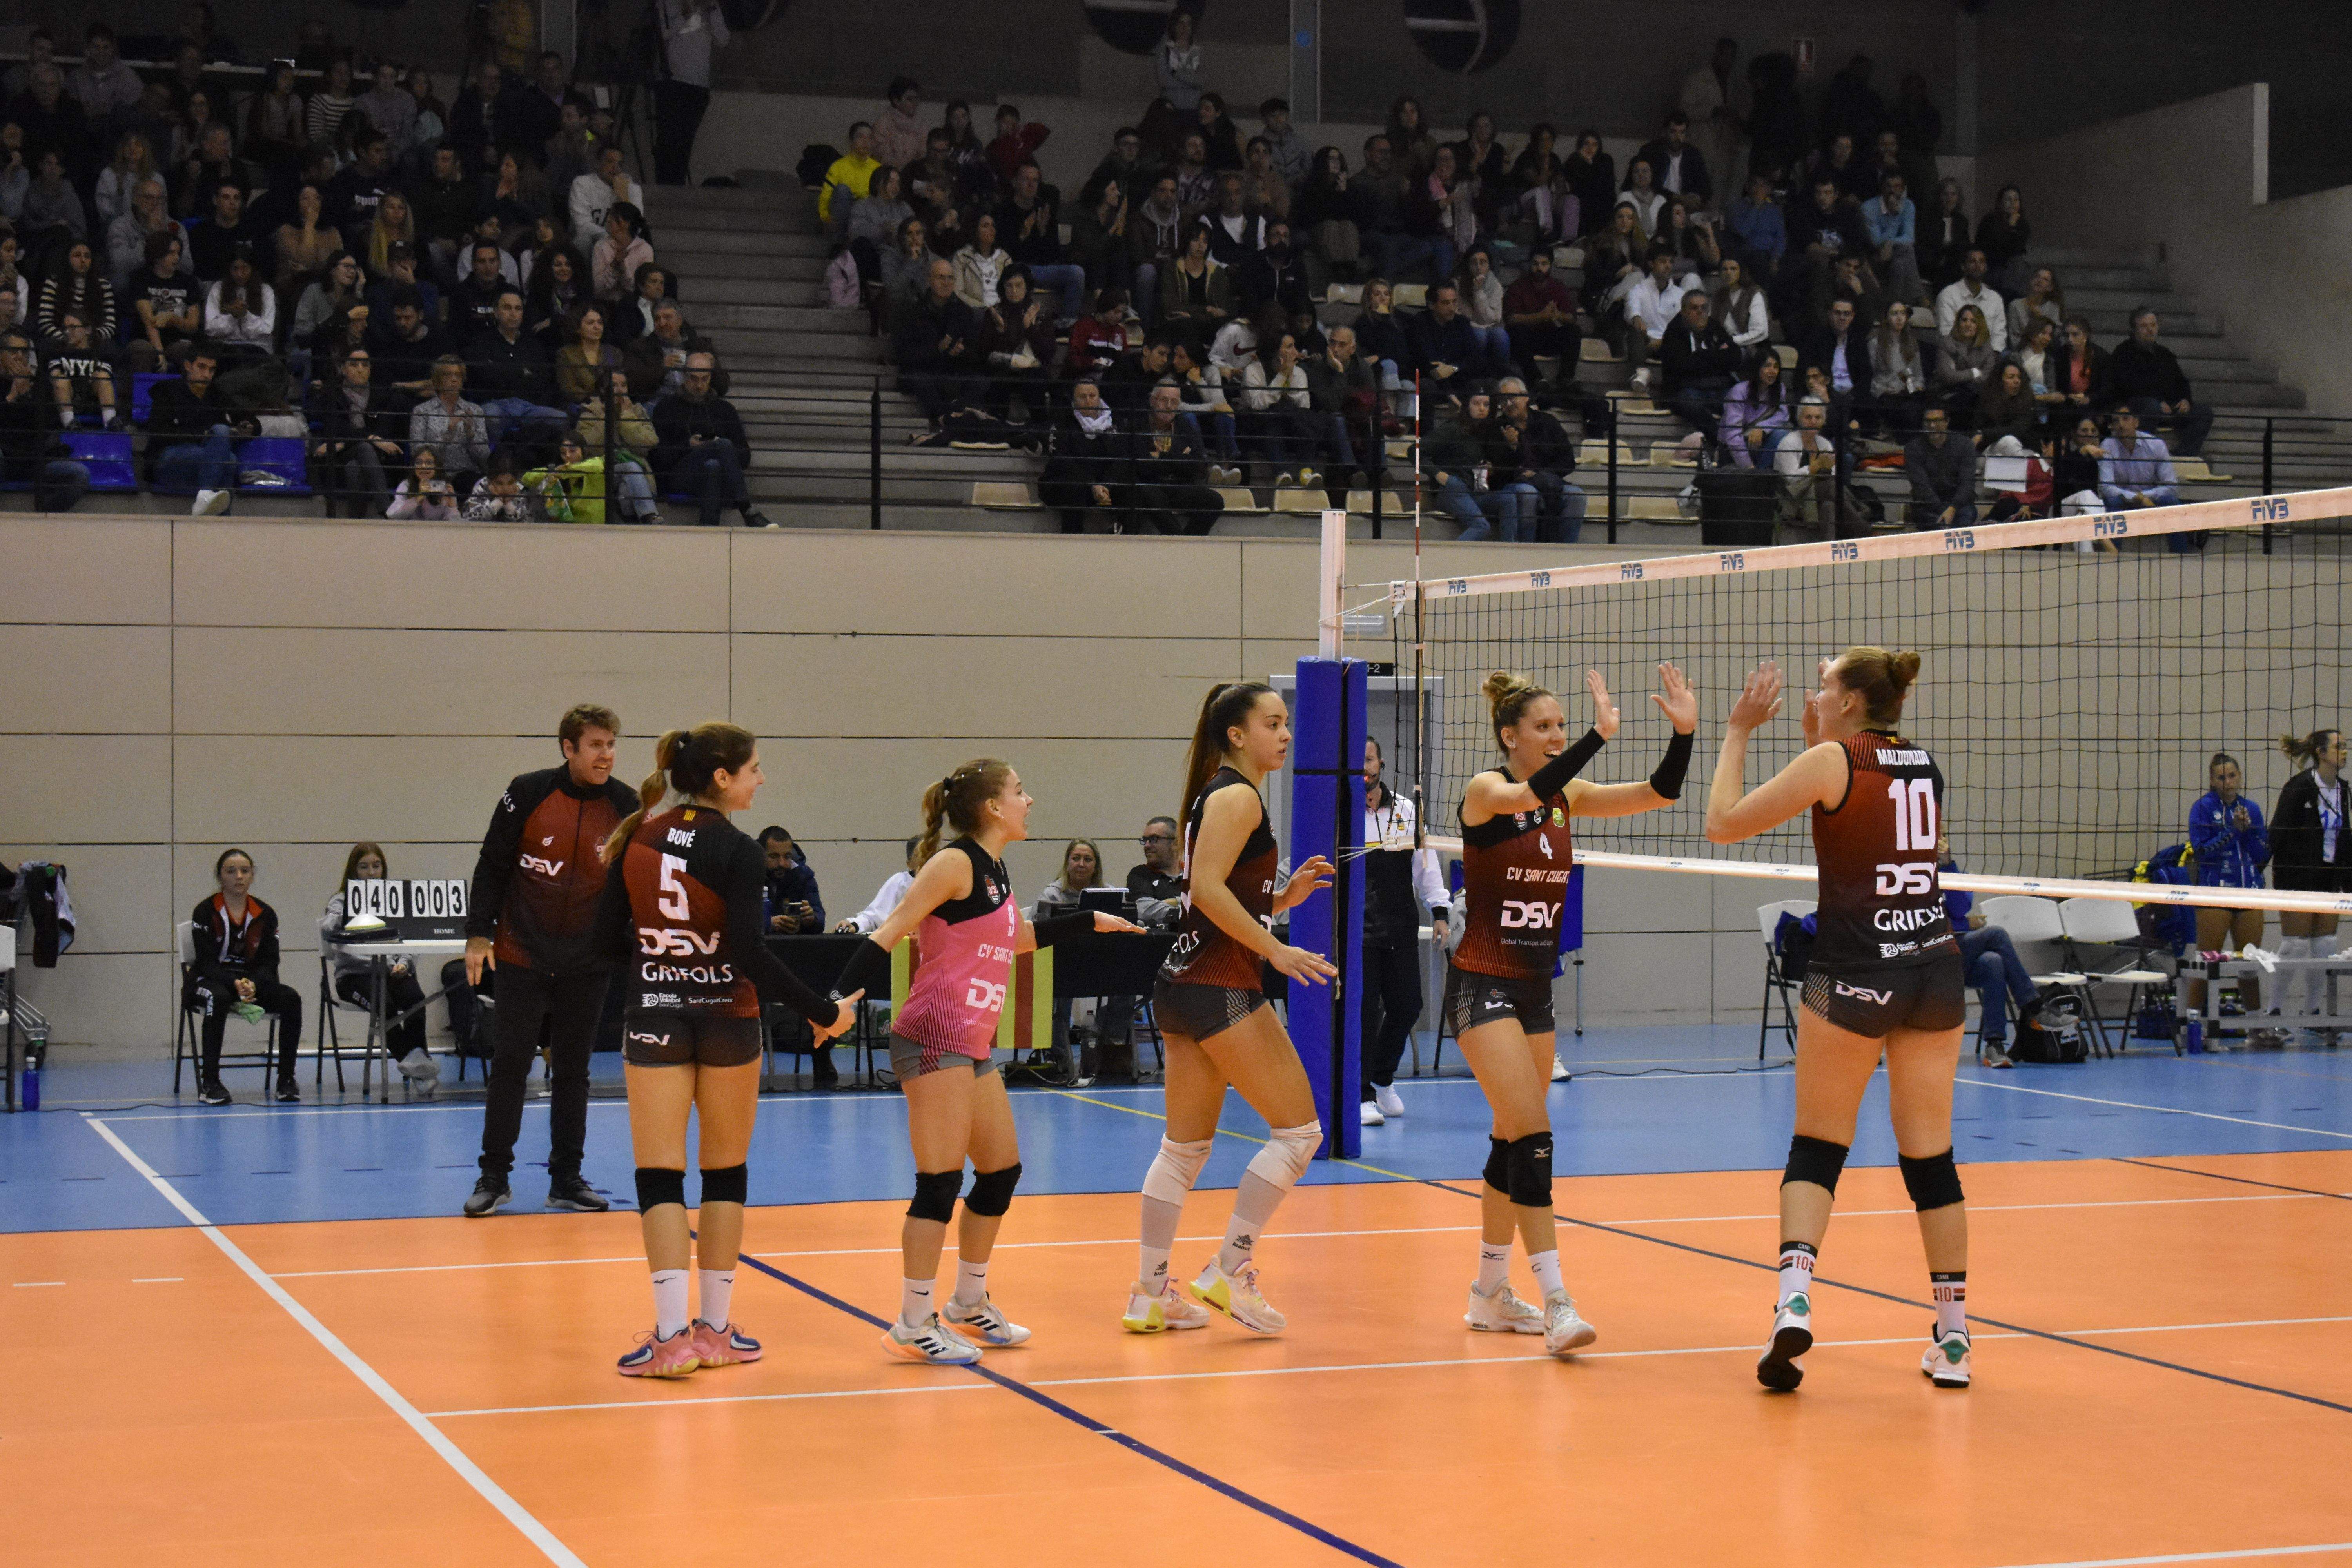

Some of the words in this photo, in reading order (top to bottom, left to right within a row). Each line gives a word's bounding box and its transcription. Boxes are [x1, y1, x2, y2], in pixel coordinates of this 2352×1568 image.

[1875, 749, 1930, 766] MALDONADO
[1888, 778, 1936, 850] 10
[667, 827, 696, 848] BOVÉ
[1539, 832, 1553, 860] 4
[520, 853, 564, 876] DSV
[1507, 867, 1523, 880] CV
[1524, 869, 1544, 882] SANT
[659, 853, 690, 920] 5
[1262, 880, 1272, 894] CV
[1008, 904, 1015, 937] 9
[1501, 900, 1561, 929] DSV
[639, 927, 720, 956] DSV
[978, 943, 993, 958] CV
[642, 962, 733, 984] GRIFOLS
[1835, 980, 1893, 1005] DSV
[1796, 1255, 1808, 1270] 10
[1938, 1286, 1951, 1302] 10
